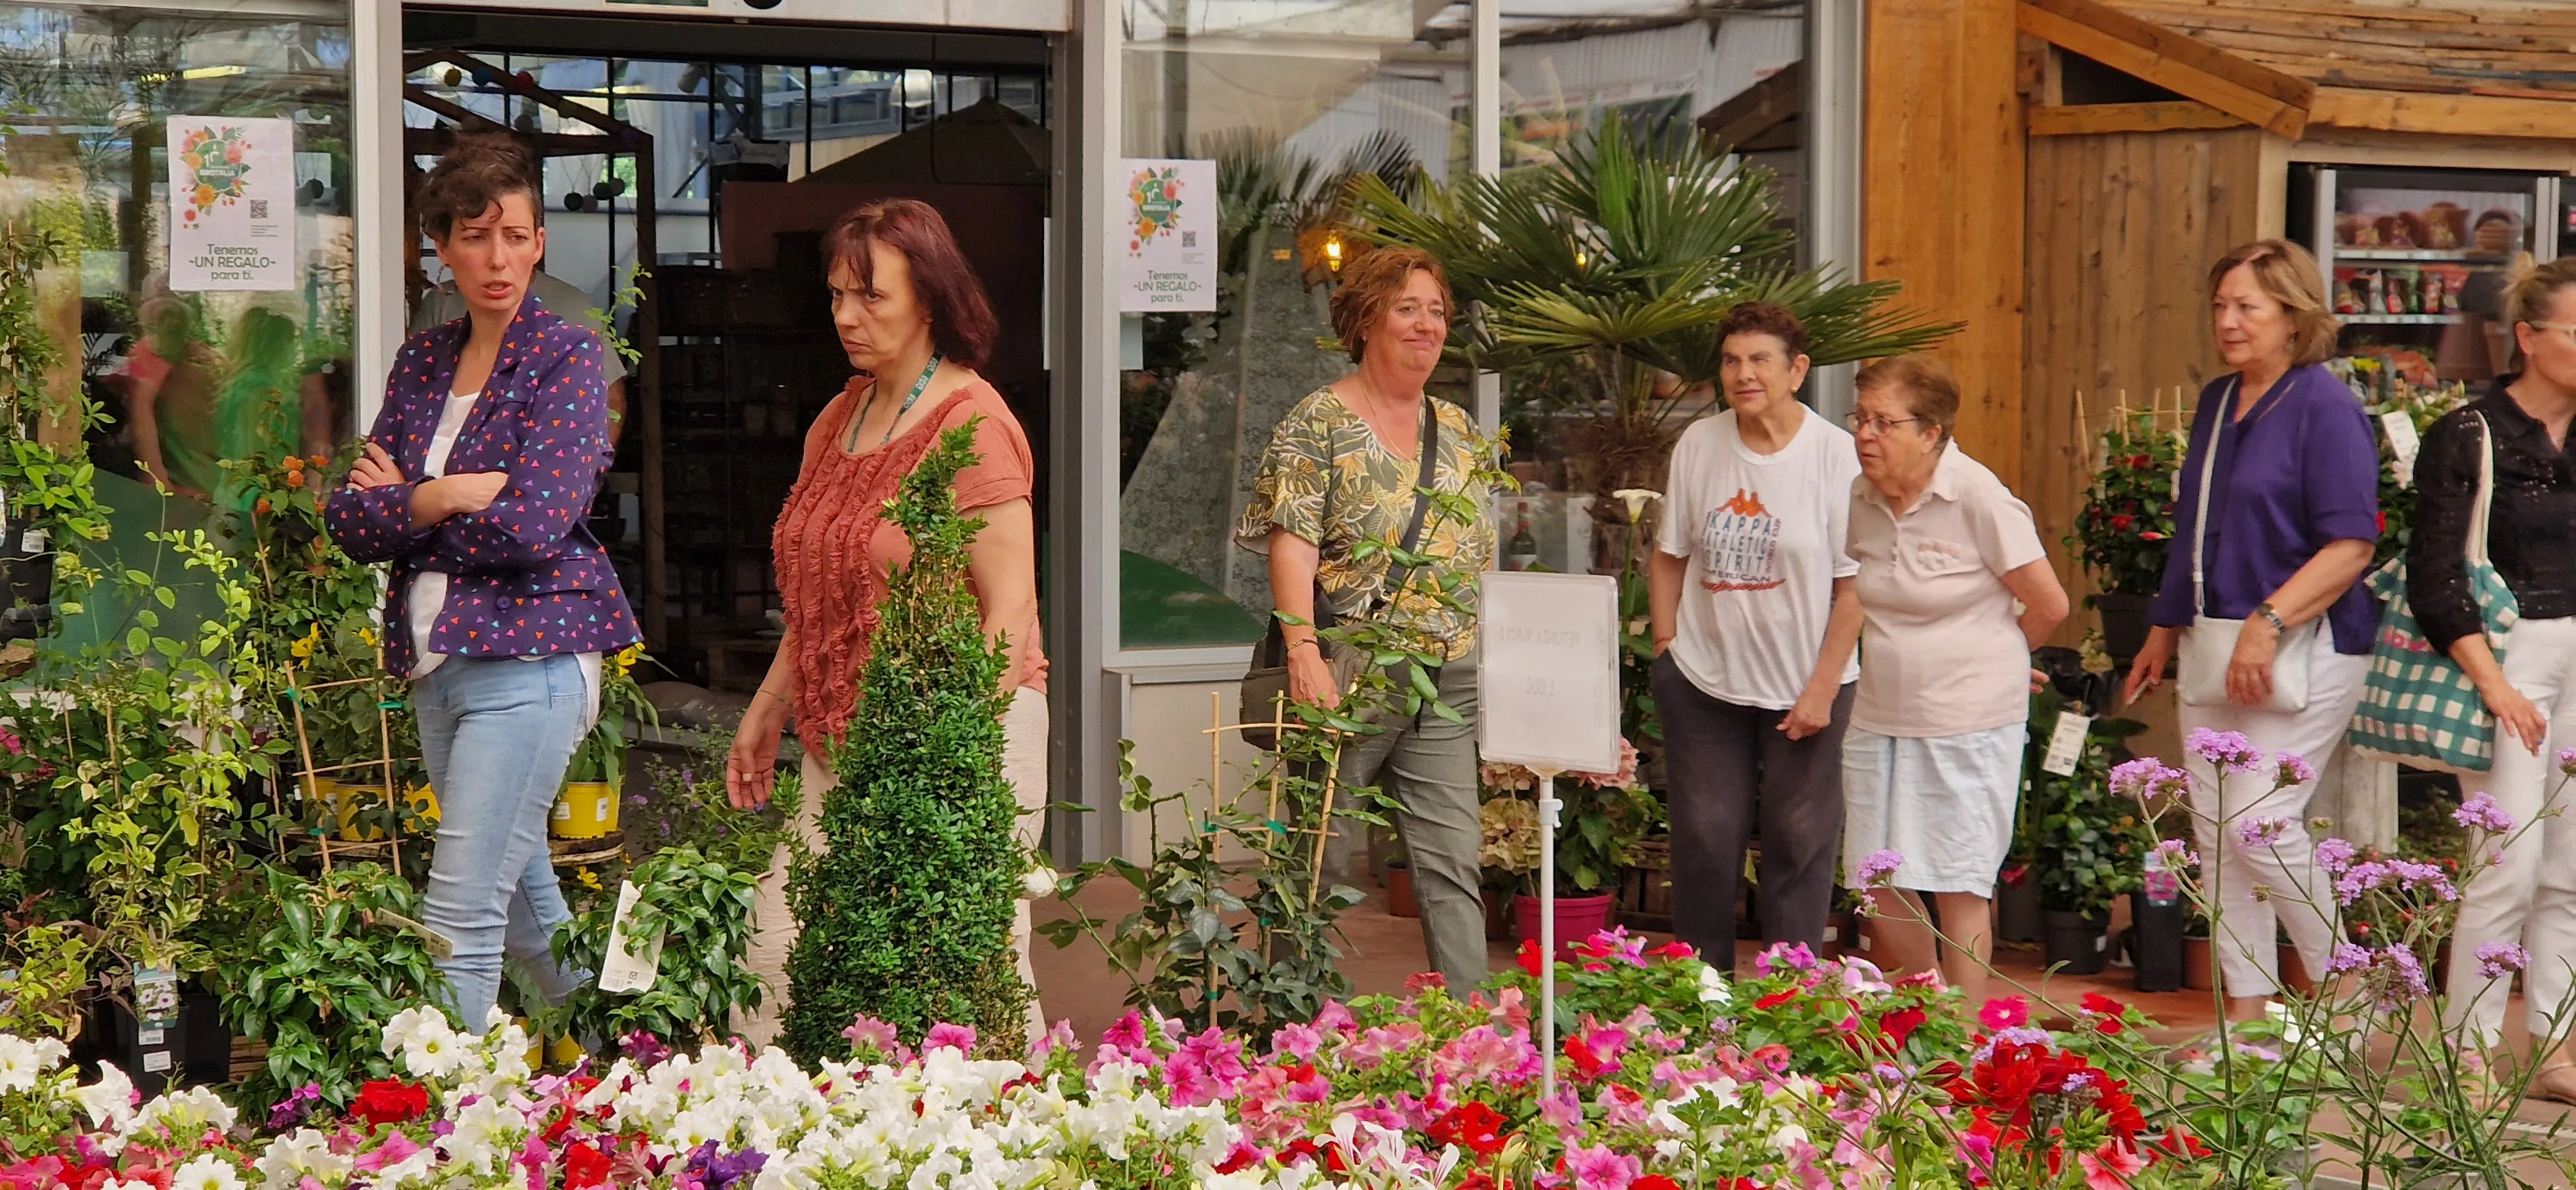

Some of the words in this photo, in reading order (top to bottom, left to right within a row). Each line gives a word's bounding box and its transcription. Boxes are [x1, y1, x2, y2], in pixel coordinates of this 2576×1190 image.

[207, 243, 258, 256] Tenemos
[211, 270, 240, 282] para
[1148, 270, 1188, 281] Tenemos
[1151, 294, 1174, 304] para
[1709, 511, 1772, 536] KAPPA
[1705, 530, 1767, 555] ATHLETIC
[1705, 549, 1765, 574] SPIRIT
